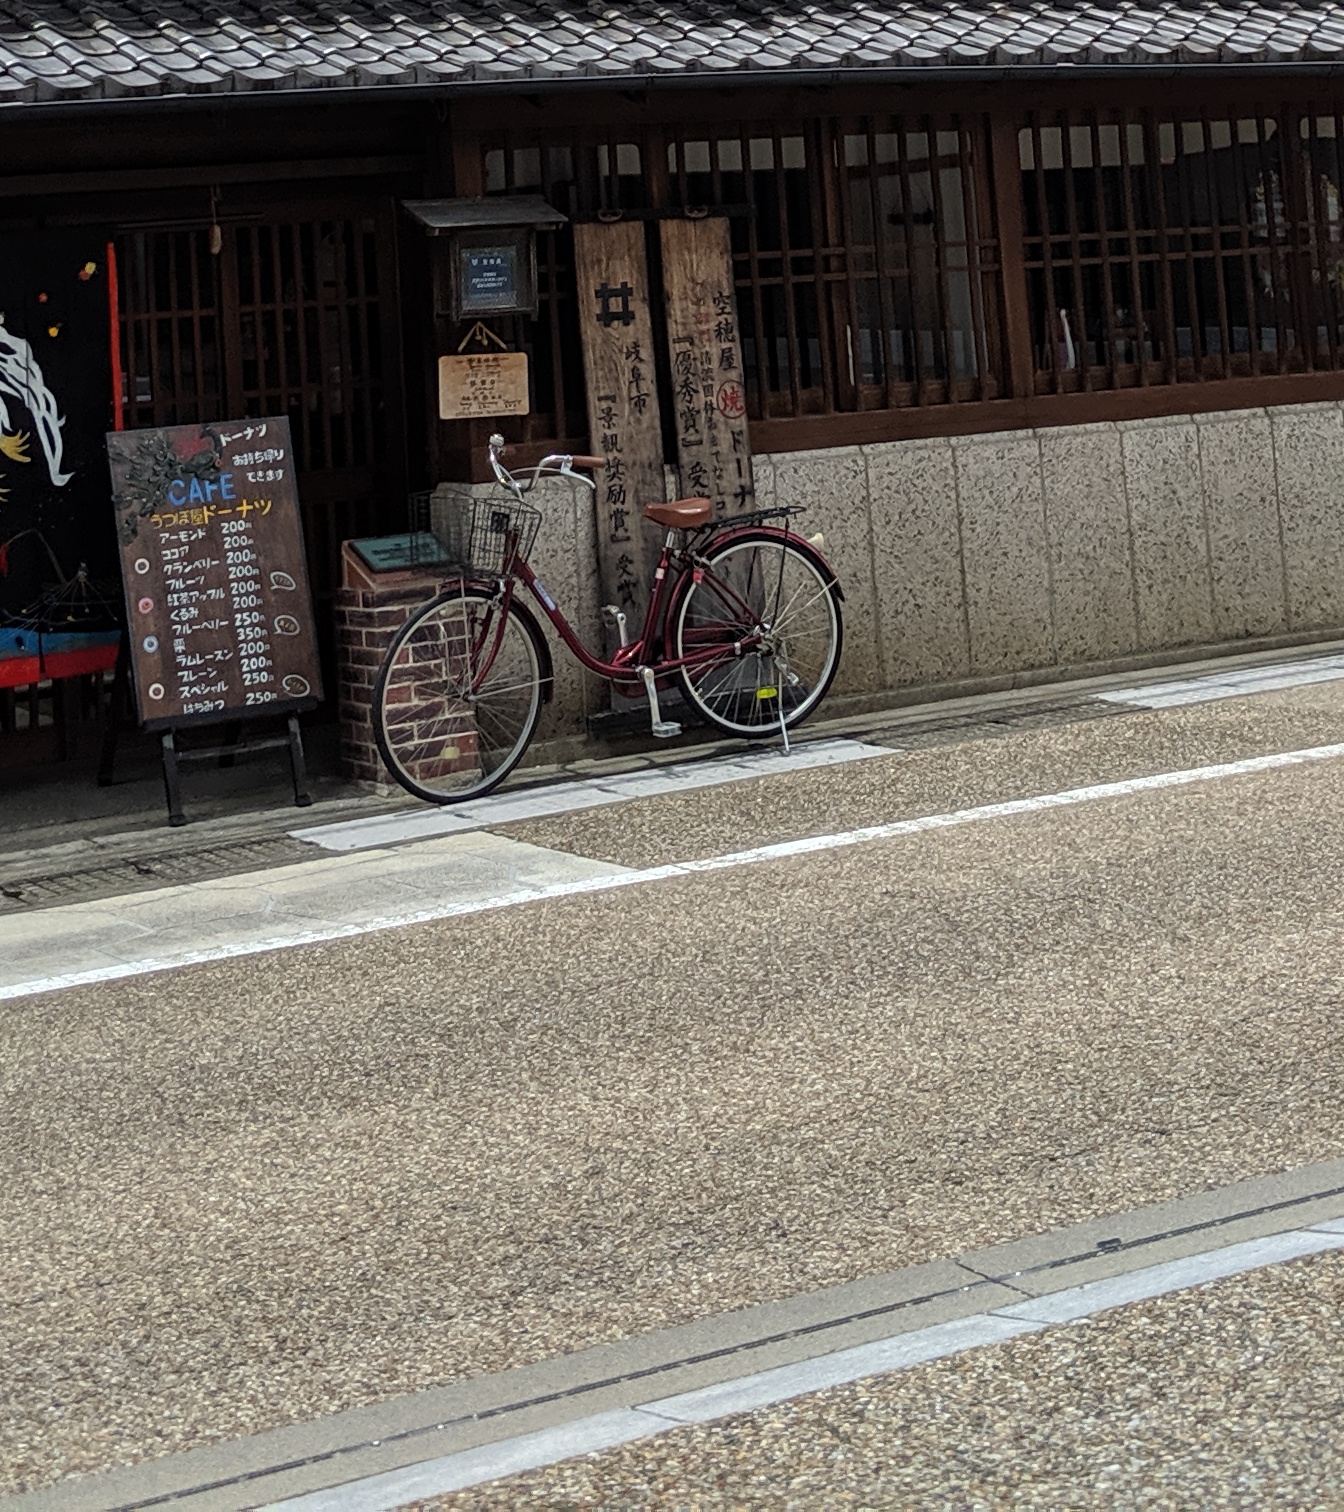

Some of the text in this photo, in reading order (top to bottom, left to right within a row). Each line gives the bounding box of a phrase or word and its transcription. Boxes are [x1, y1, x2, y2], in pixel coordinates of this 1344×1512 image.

[625, 341, 650, 414] 岐阜市
[219, 424, 267, 447] ドーナツ
[246, 469, 284, 483] できます
[168, 473, 236, 506] CAFE
[159, 528, 206, 544] アーモンド
[161, 545, 189, 560] ココア
